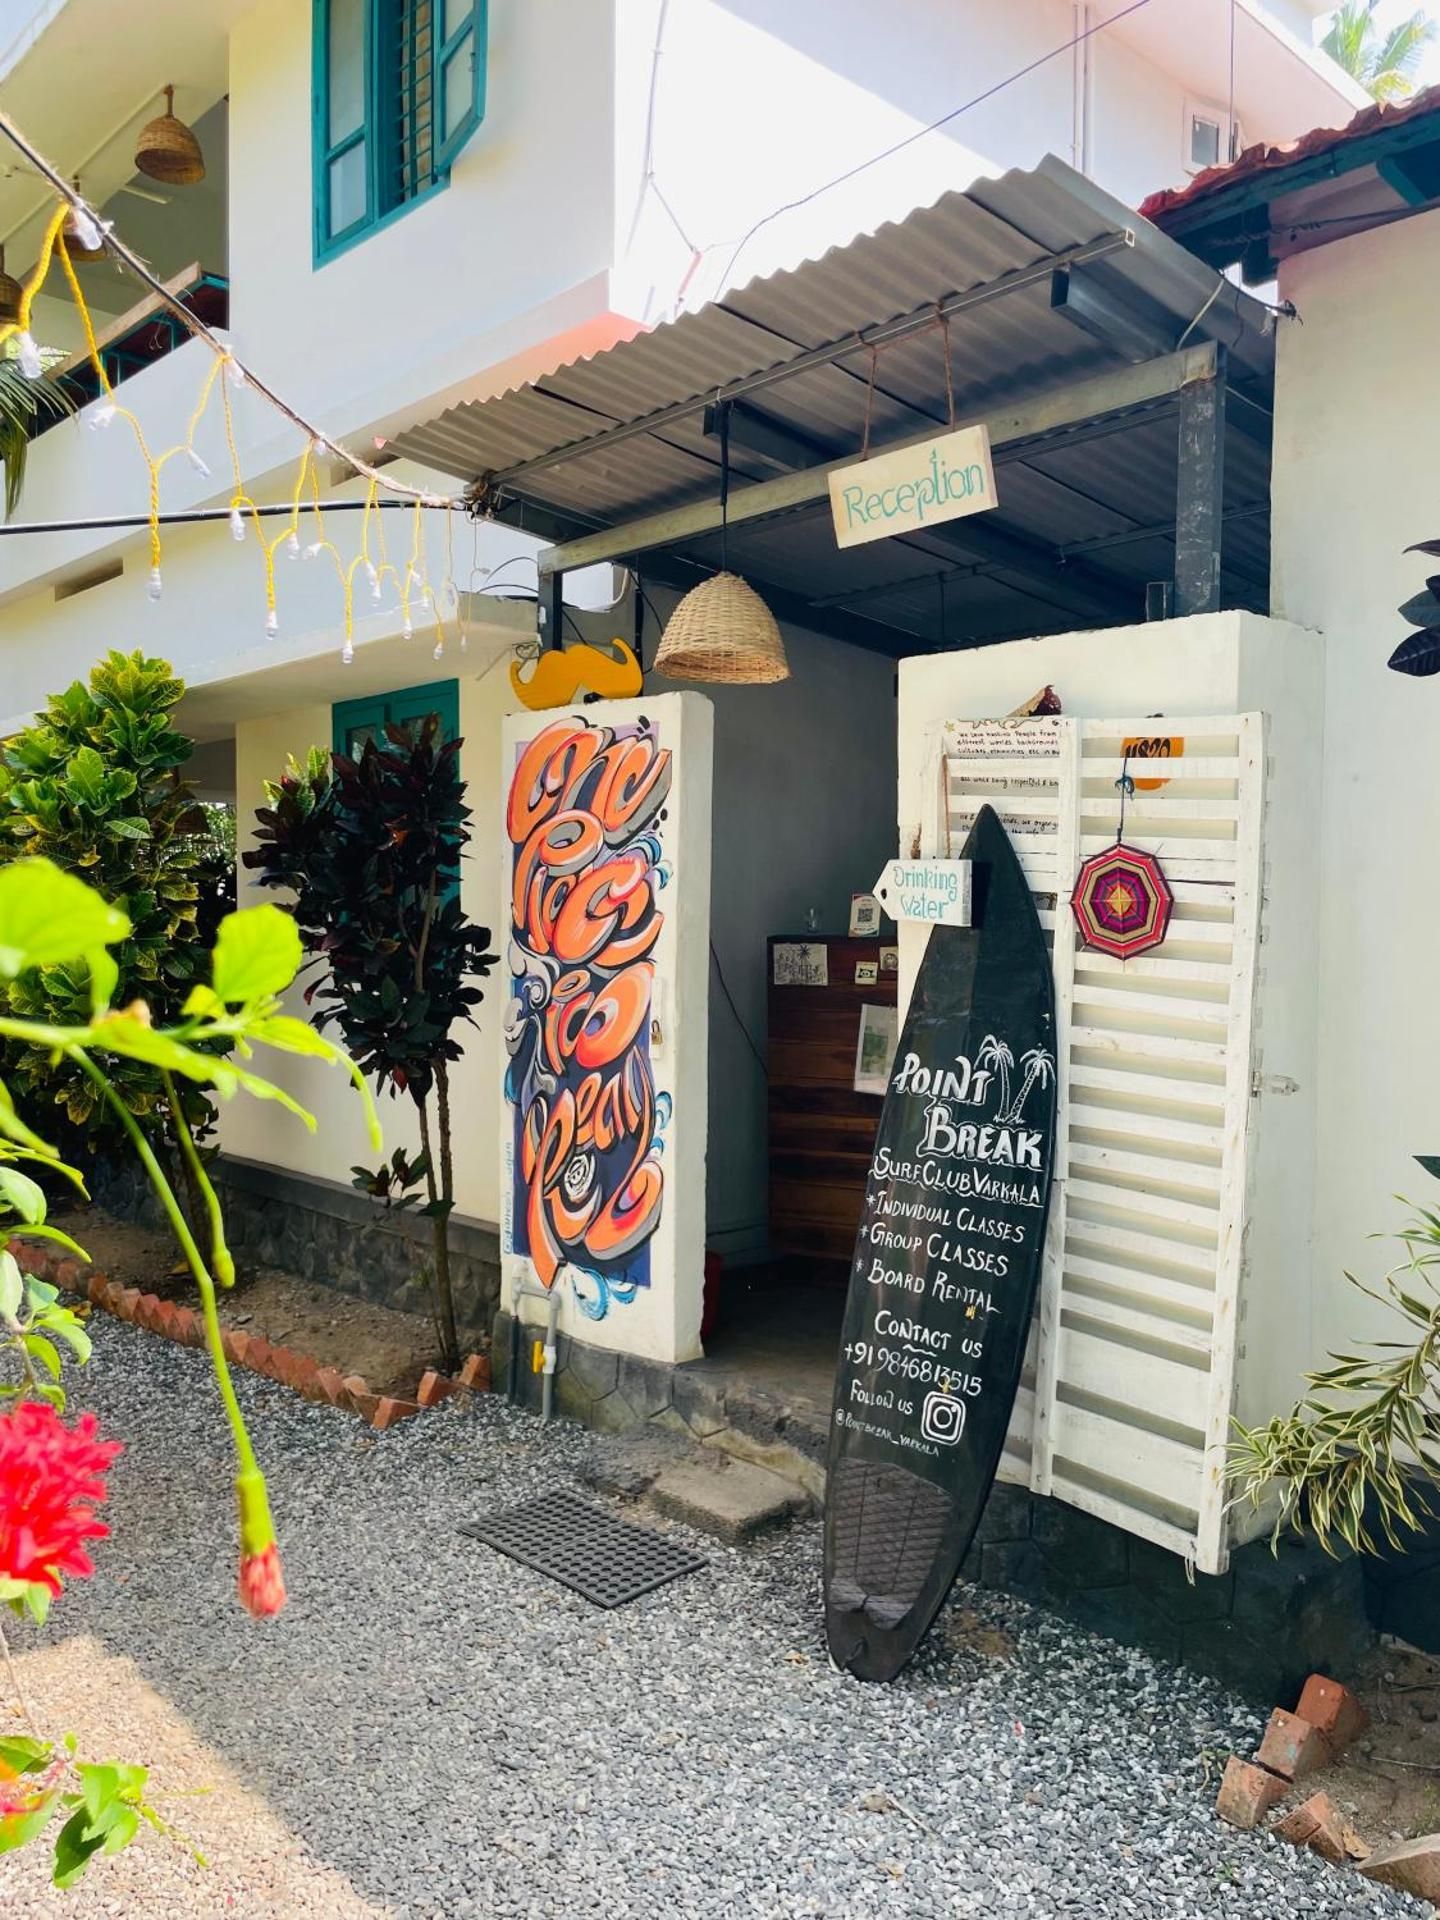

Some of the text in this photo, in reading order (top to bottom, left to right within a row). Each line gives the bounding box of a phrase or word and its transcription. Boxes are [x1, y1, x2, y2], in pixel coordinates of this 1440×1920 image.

[842, 448, 984, 528] Reception
[893, 866, 957, 901] Drinking
[900, 892, 949, 919] Water
[894, 1052, 993, 1103] POINT
[924, 1104, 1044, 1169] BREAK
[874, 1190, 1026, 1243] INDIVIDUAL CLASSES
[869, 1221, 1009, 1277] GROUP CLASSES
[867, 1257, 1002, 1313] BOARD RENTAL
[874, 1309, 951, 1350] CONTACT
[850, 1378, 893, 1409] FOLLOW
